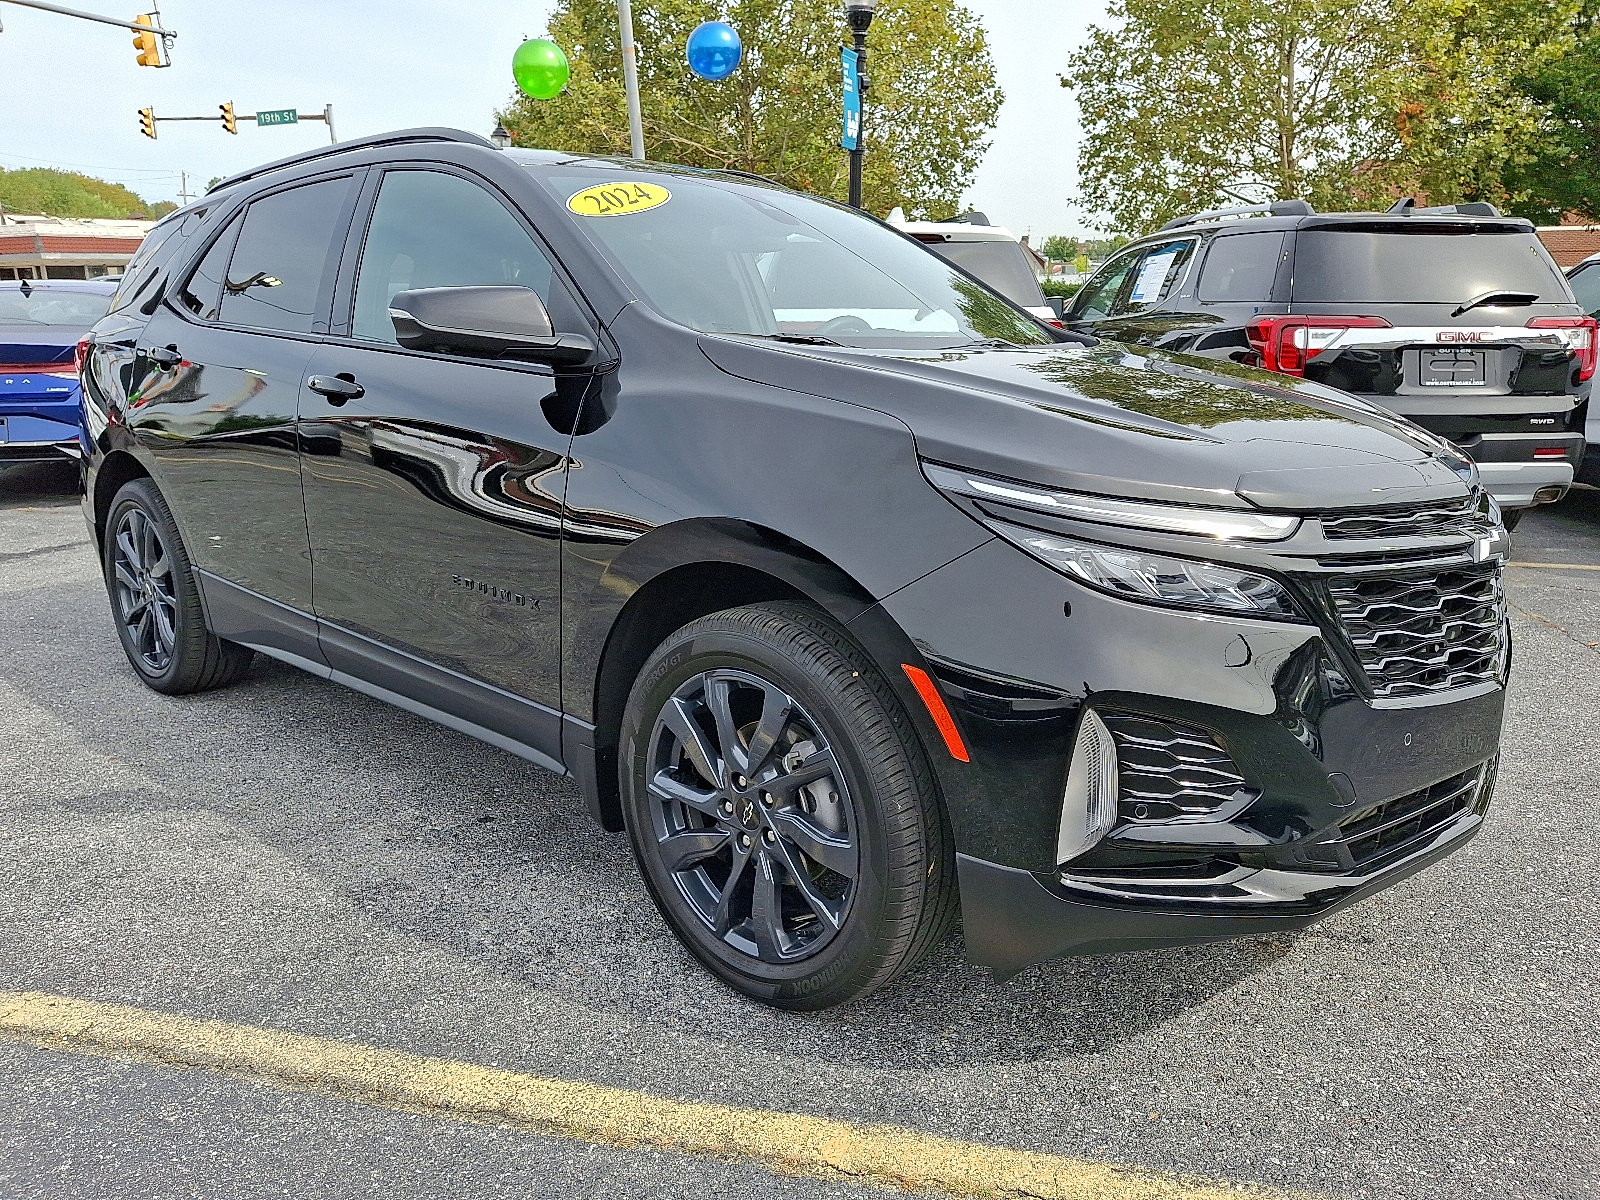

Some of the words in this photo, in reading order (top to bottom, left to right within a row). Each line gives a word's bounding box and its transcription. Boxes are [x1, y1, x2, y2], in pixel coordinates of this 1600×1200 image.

[260, 113, 280, 122] 19th
[284, 112, 294, 121] St
[583, 184, 653, 213] 2024
[1436, 331, 1495, 343] GMC
